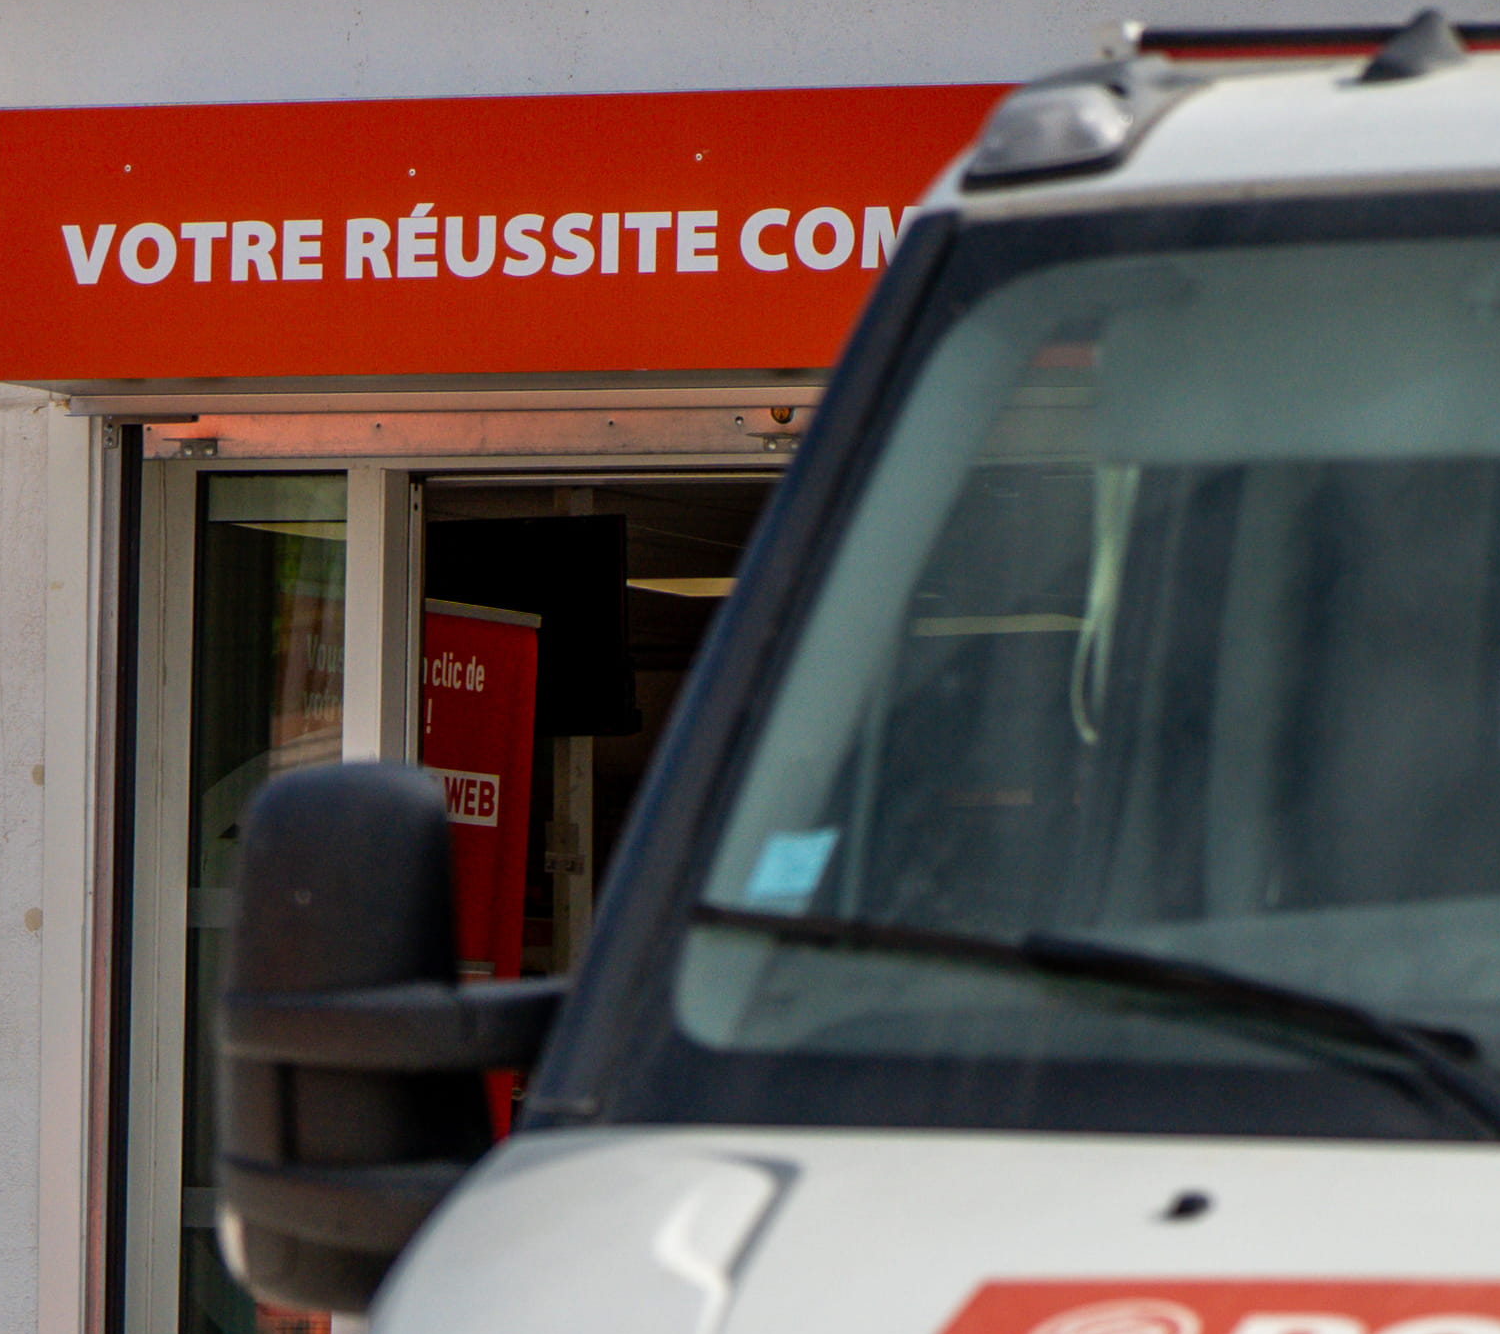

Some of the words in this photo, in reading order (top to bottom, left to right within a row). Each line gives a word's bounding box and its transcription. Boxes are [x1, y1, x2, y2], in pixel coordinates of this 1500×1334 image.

[62, 218, 324, 285] VOTRE
[344, 202, 719, 280] RÉUSSITE
[432, 651, 463, 690] clic
[465, 654, 486, 692] de
[445, 776, 496, 818] WEB
